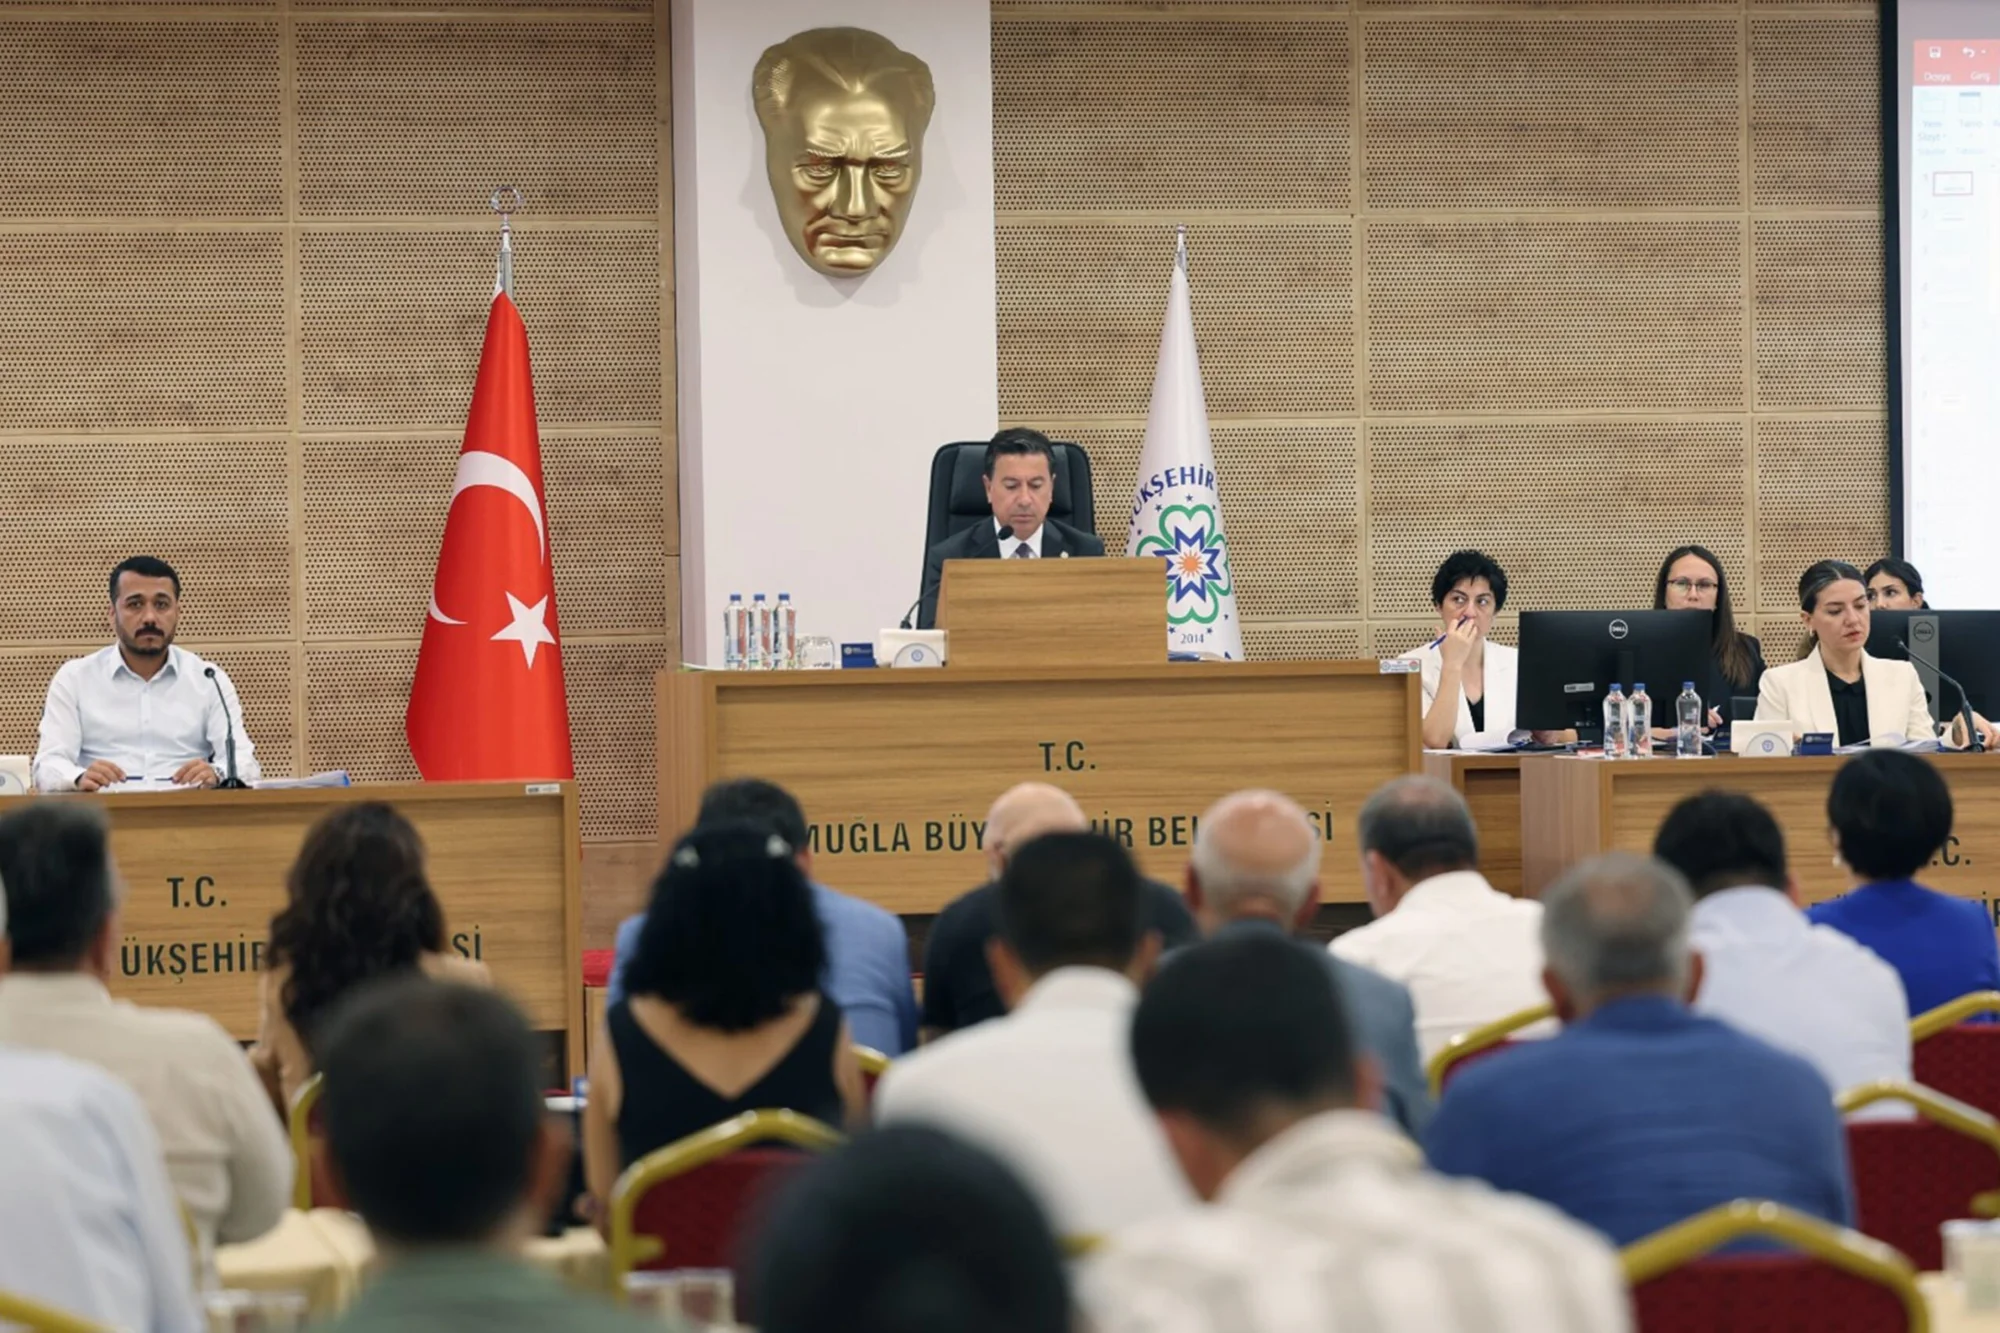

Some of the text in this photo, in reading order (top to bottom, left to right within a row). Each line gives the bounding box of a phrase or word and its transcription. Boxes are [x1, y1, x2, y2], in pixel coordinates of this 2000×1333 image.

[1129, 463, 1214, 527] ÜKŞEHİR
[1181, 633, 1205, 645] 2014
[1039, 740, 1097, 772] T.C.
[1931, 835, 1971, 867] .C.
[166, 875, 227, 908] T.C.
[120, 932, 267, 983] ÜKŞEHİR
